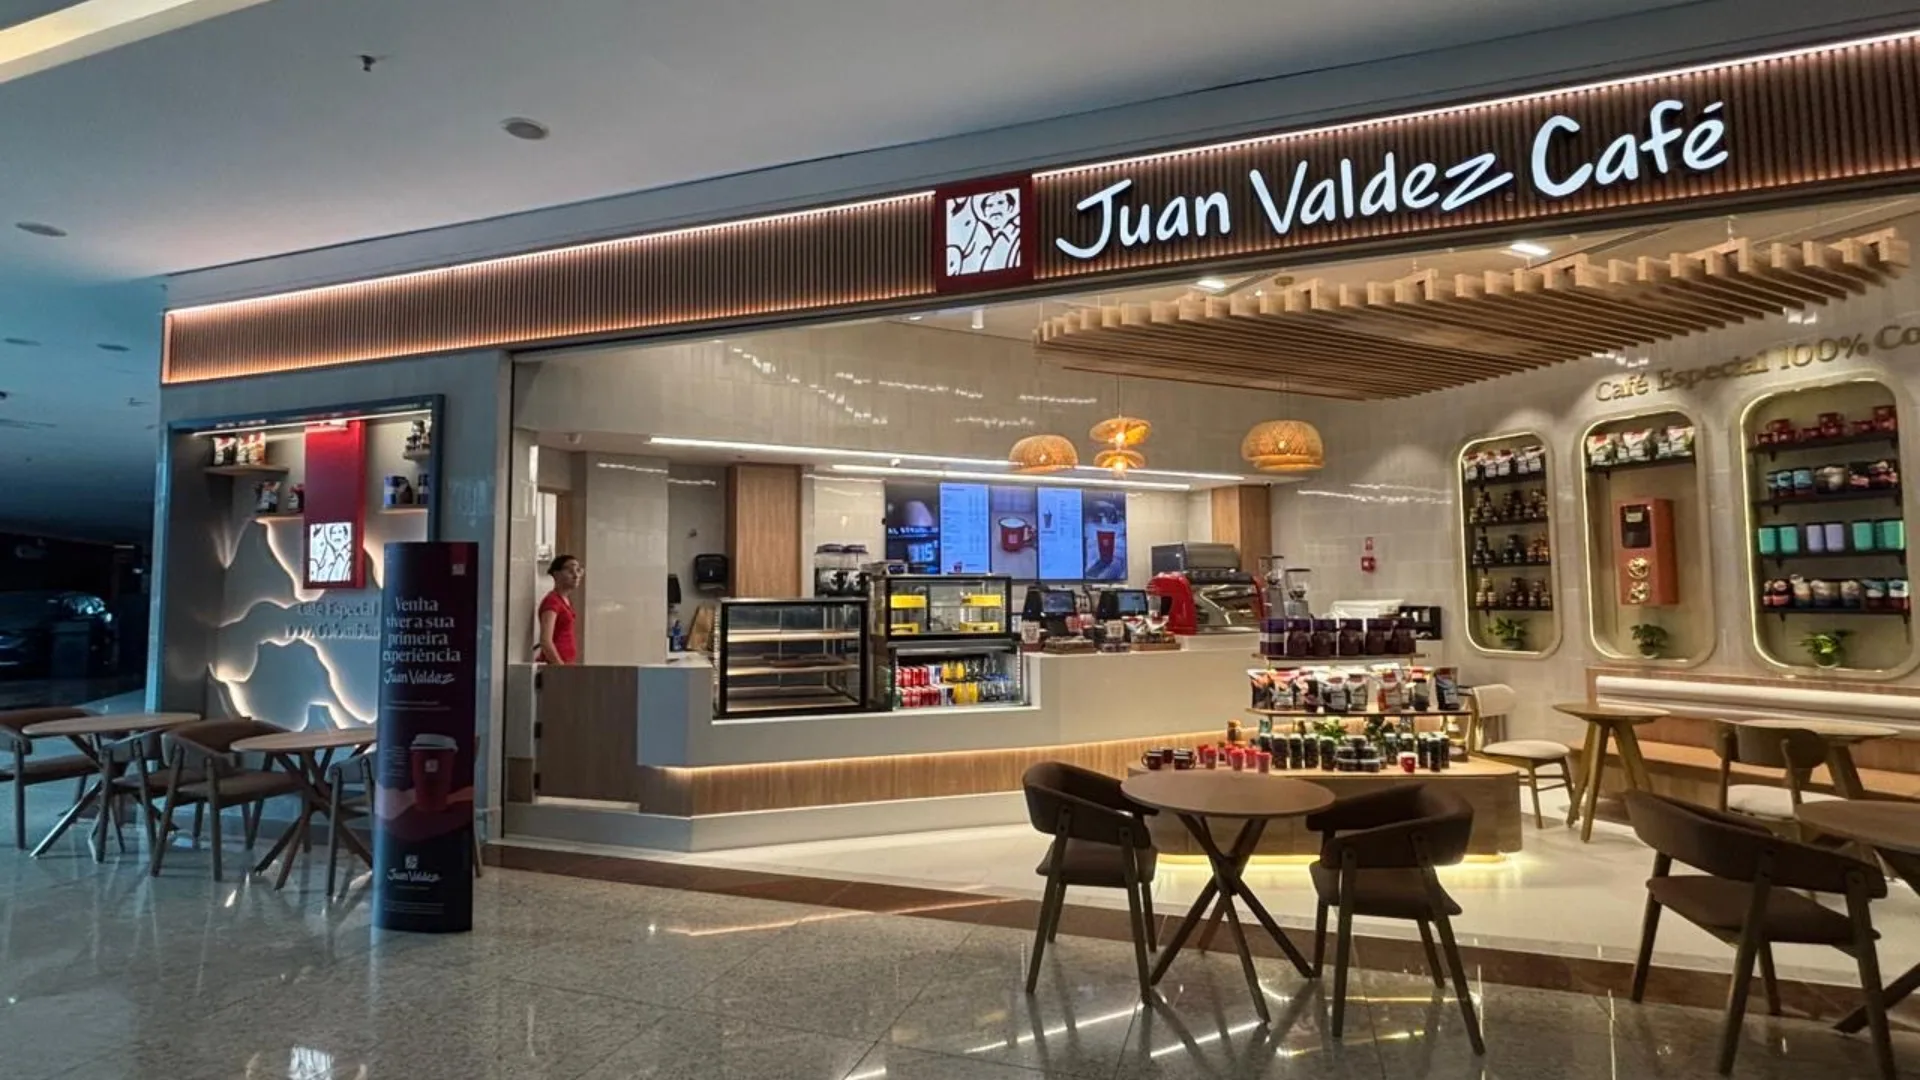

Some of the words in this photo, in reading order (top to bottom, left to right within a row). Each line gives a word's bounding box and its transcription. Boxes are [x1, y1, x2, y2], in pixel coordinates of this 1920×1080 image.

[1056, 179, 1230, 259] Juan
[1249, 151, 1513, 234] Valdez
[1532, 100, 1729, 197] Café
[1595, 371, 1648, 402] Café
[1656, 350, 1769, 391] Especial
[1780, 332, 1870, 370] 100%
[395, 597, 438, 611] Venha
[414, 616, 423, 628] a
[425, 616, 455, 628] sua
[388, 631, 449, 647] primeira
[384, 667, 408, 684] Juan
[408, 669, 455, 684] Valdez
